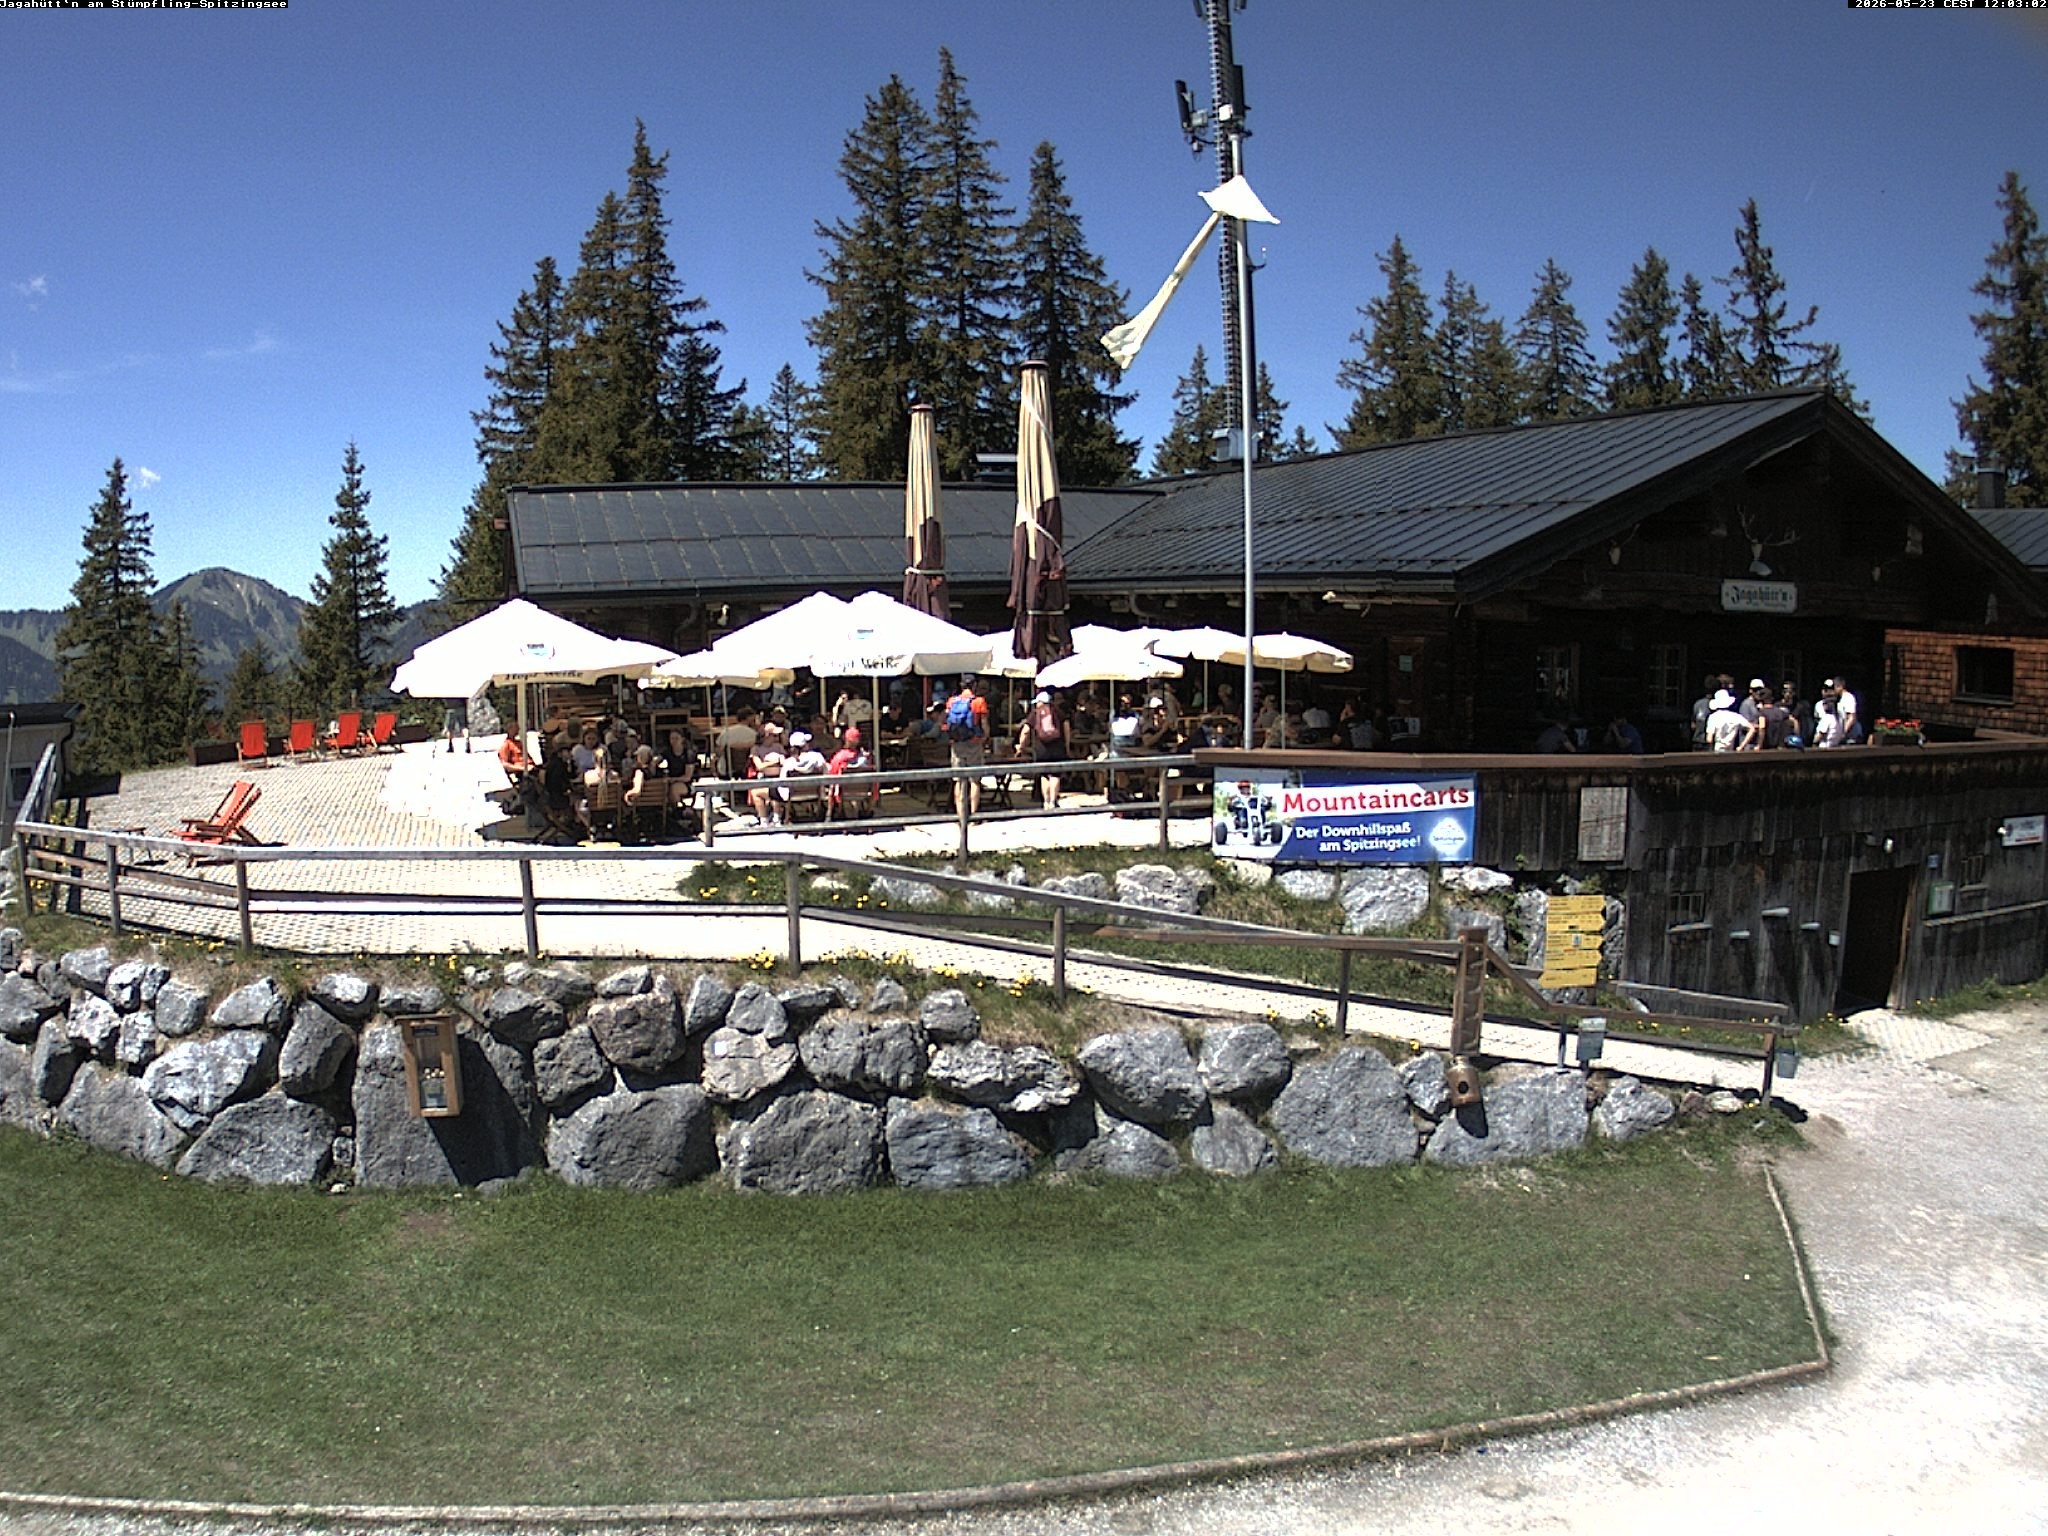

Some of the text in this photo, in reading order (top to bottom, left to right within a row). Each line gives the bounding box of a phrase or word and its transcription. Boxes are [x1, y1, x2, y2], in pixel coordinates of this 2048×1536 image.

[1283, 786, 1469, 813] Mountaincarts
[1295, 821, 1411, 838] Der Downhillspaß
[1319, 841, 1341, 852] am
[1343, 836, 1421, 853] Spitzingsee!
